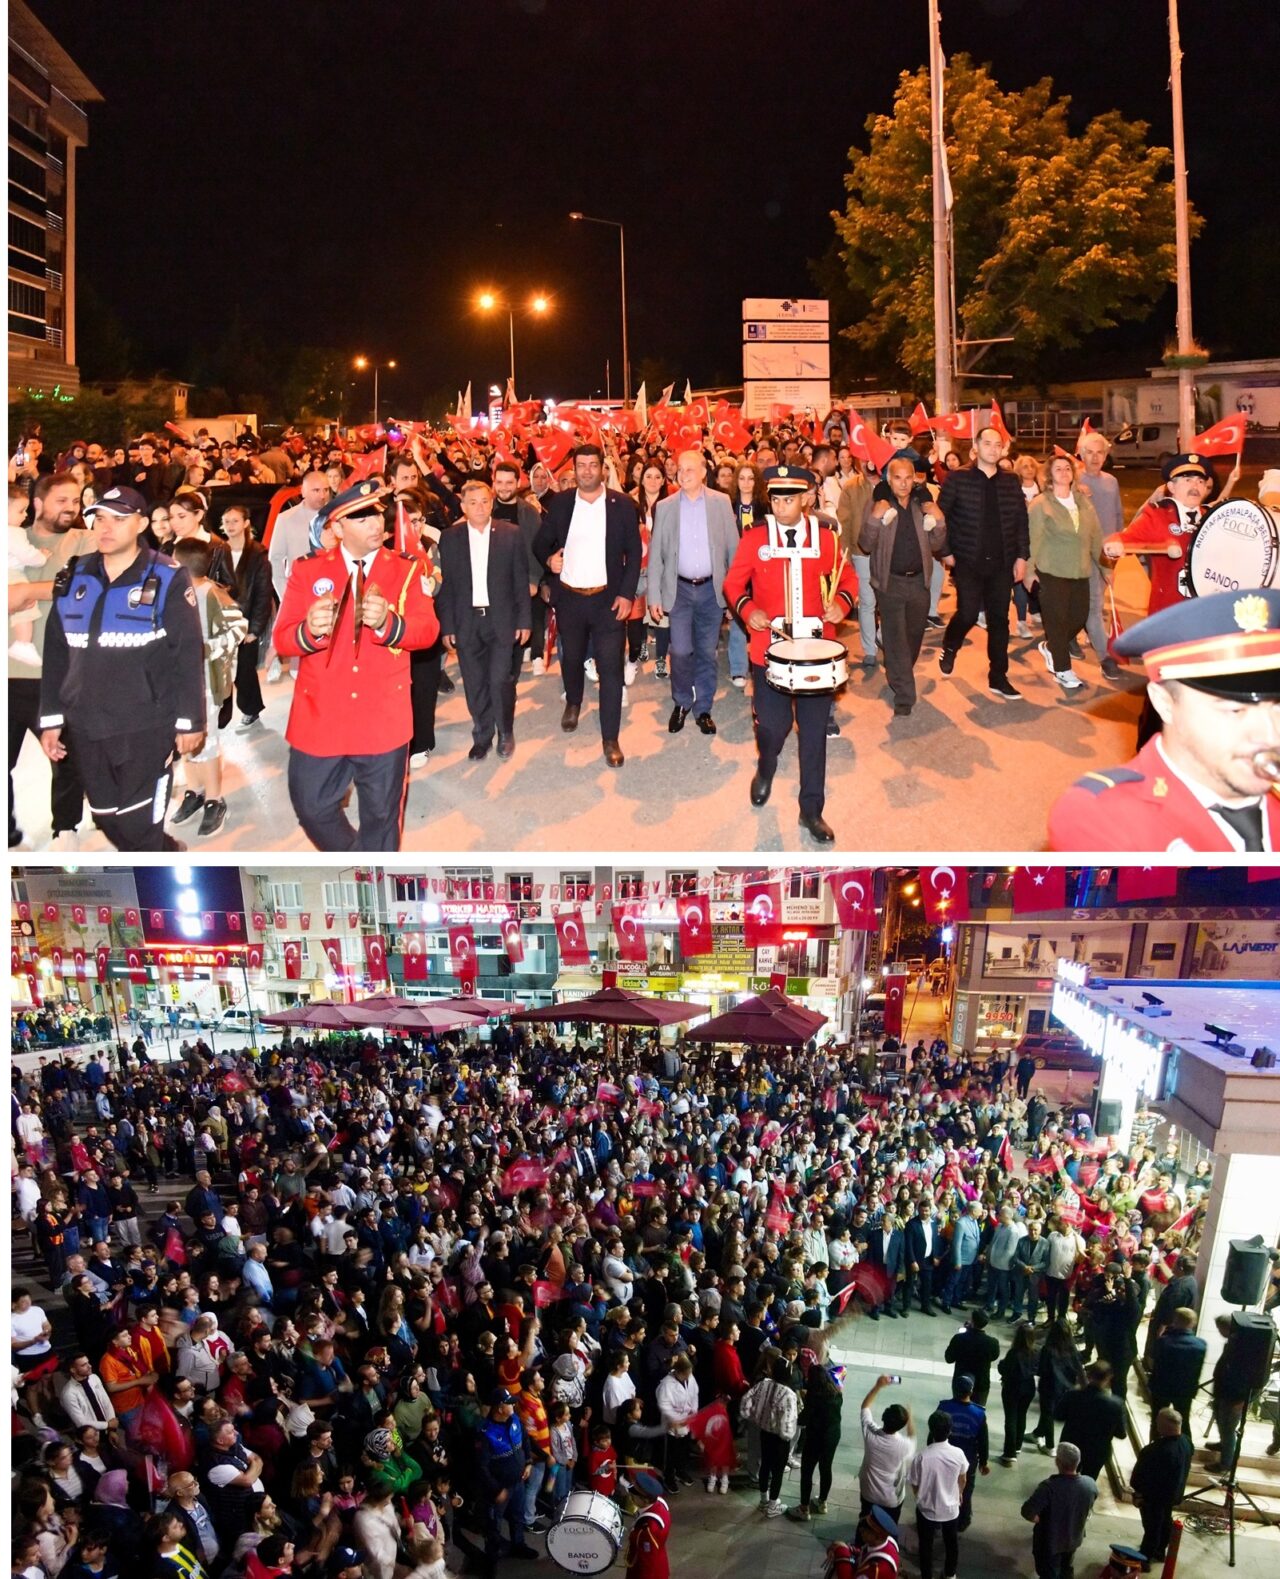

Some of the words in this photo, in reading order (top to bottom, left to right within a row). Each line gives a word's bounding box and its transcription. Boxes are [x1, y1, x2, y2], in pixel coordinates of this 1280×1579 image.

[1222, 517, 1259, 538] FOCUS
[1204, 568, 1239, 592] BANDO
[985, 1011, 1015, 1022] 9950
[567, 1552, 599, 1560] BANDO
